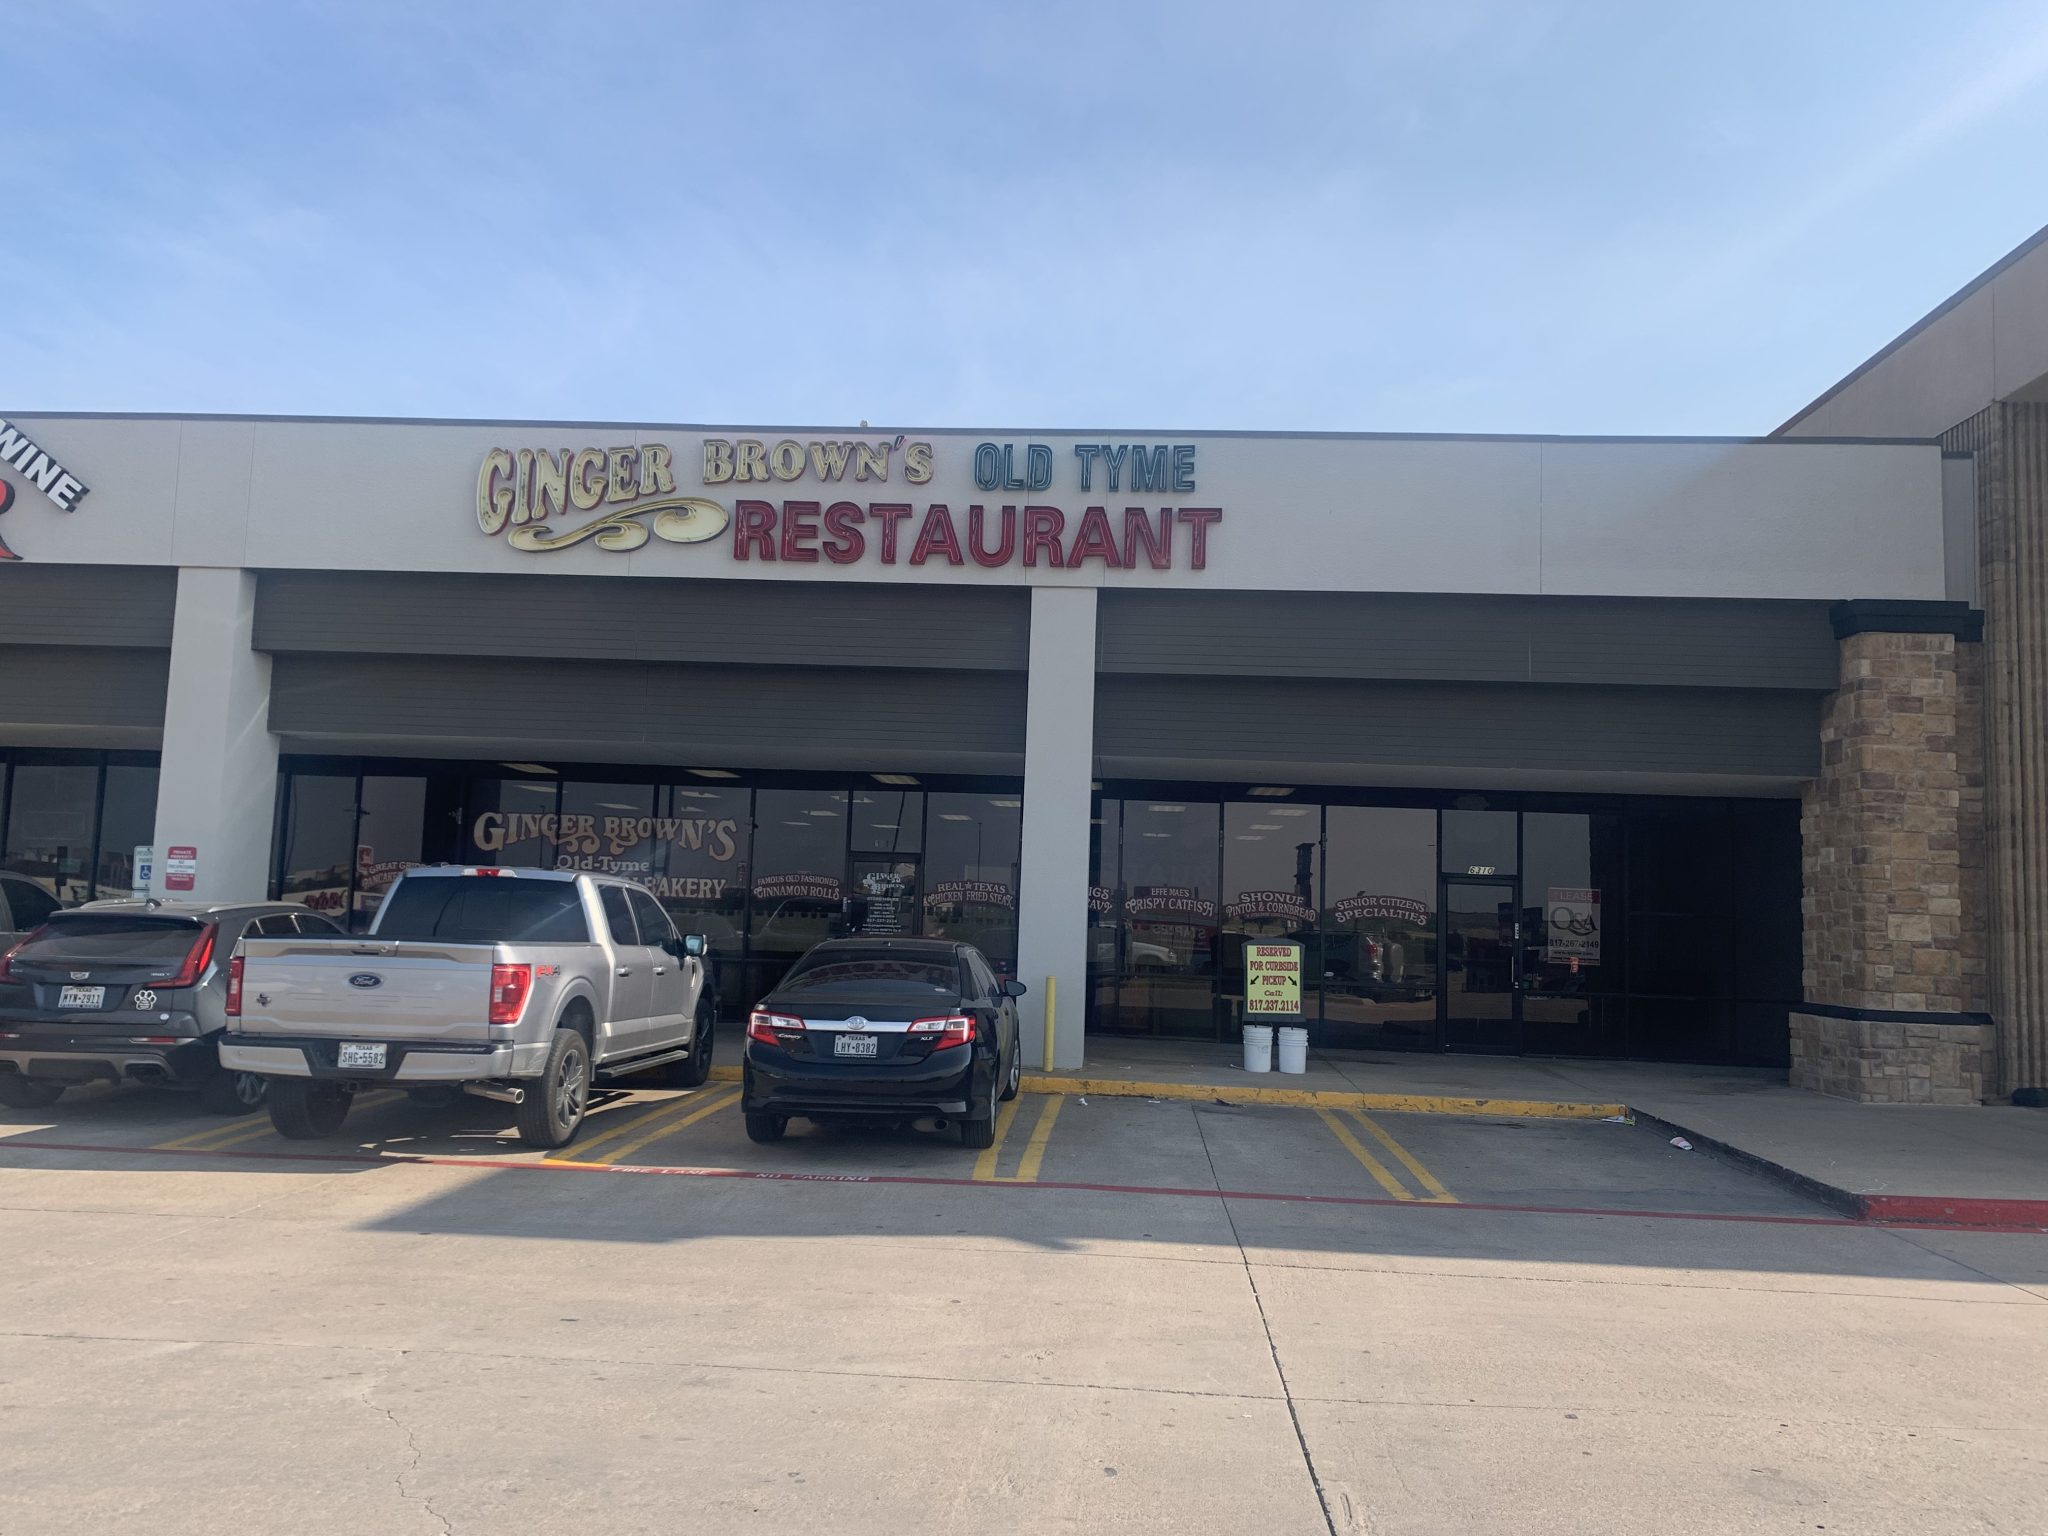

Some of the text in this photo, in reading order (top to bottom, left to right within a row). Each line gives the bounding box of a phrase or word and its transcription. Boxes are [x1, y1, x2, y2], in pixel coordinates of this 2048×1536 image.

[0, 418, 86, 512] WINE
[974, 442, 1197, 492] OLD TYME
[475, 434, 935, 536] GINGER BROWN'S
[733, 500, 1223, 571] RESTAURANT
[473, 812, 737, 862] GINGER BROWN'S
[557, 855, 649, 874] Old-Tyme
[1469, 867, 1494, 875] 6310
[757, 874, 839, 887] FAMOUS OLD FASHIONED
[937, 882, 1006, 894] REAL TEXAS
[753, 885, 840, 901] CINNAMON ROLLS
[927, 890, 1015, 910] CHICKEN FRIED STEAK
[1560, 892, 1593, 902] LEASE
[1125, 897, 1214, 917] CRISPY CATFISH
[1226, 902, 1256, 918] PINTOS
[1258, 902, 1265, 912] &
[1266, 902, 1316, 922] CORNBREAD
[1336, 897, 1425, 913] SENIOR CITIZENS
[1335, 908, 1427, 926] SPECIALTIES
[1256, 947, 1292, 957] RESERVED
[1250, 960, 1298, 972] FOR CURBSIDE
[1262, 975, 1287, 986] PICKUP
[1249, 999, 1299, 1012] 817.237.2114
